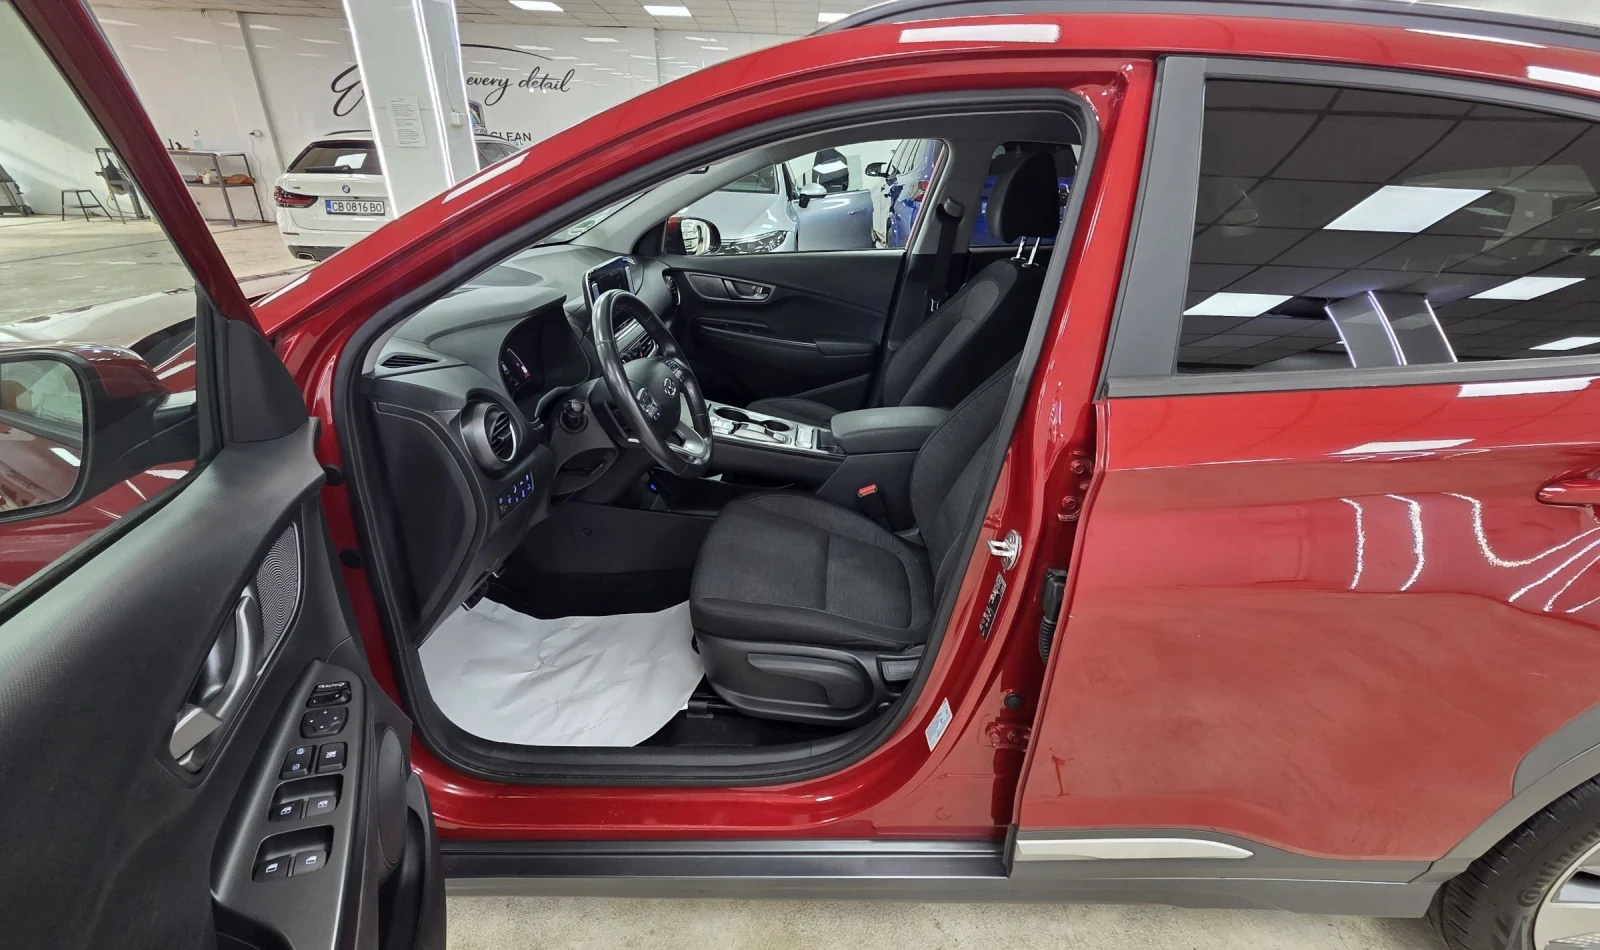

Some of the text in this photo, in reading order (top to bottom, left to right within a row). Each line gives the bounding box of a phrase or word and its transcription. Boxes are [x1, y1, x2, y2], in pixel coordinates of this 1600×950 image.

[466, 66, 575, 106] every detail
[332, 202, 344, 211] CB
[346, 202, 368, 212] 0816
[1516, 820, 1600, 907] Continen
